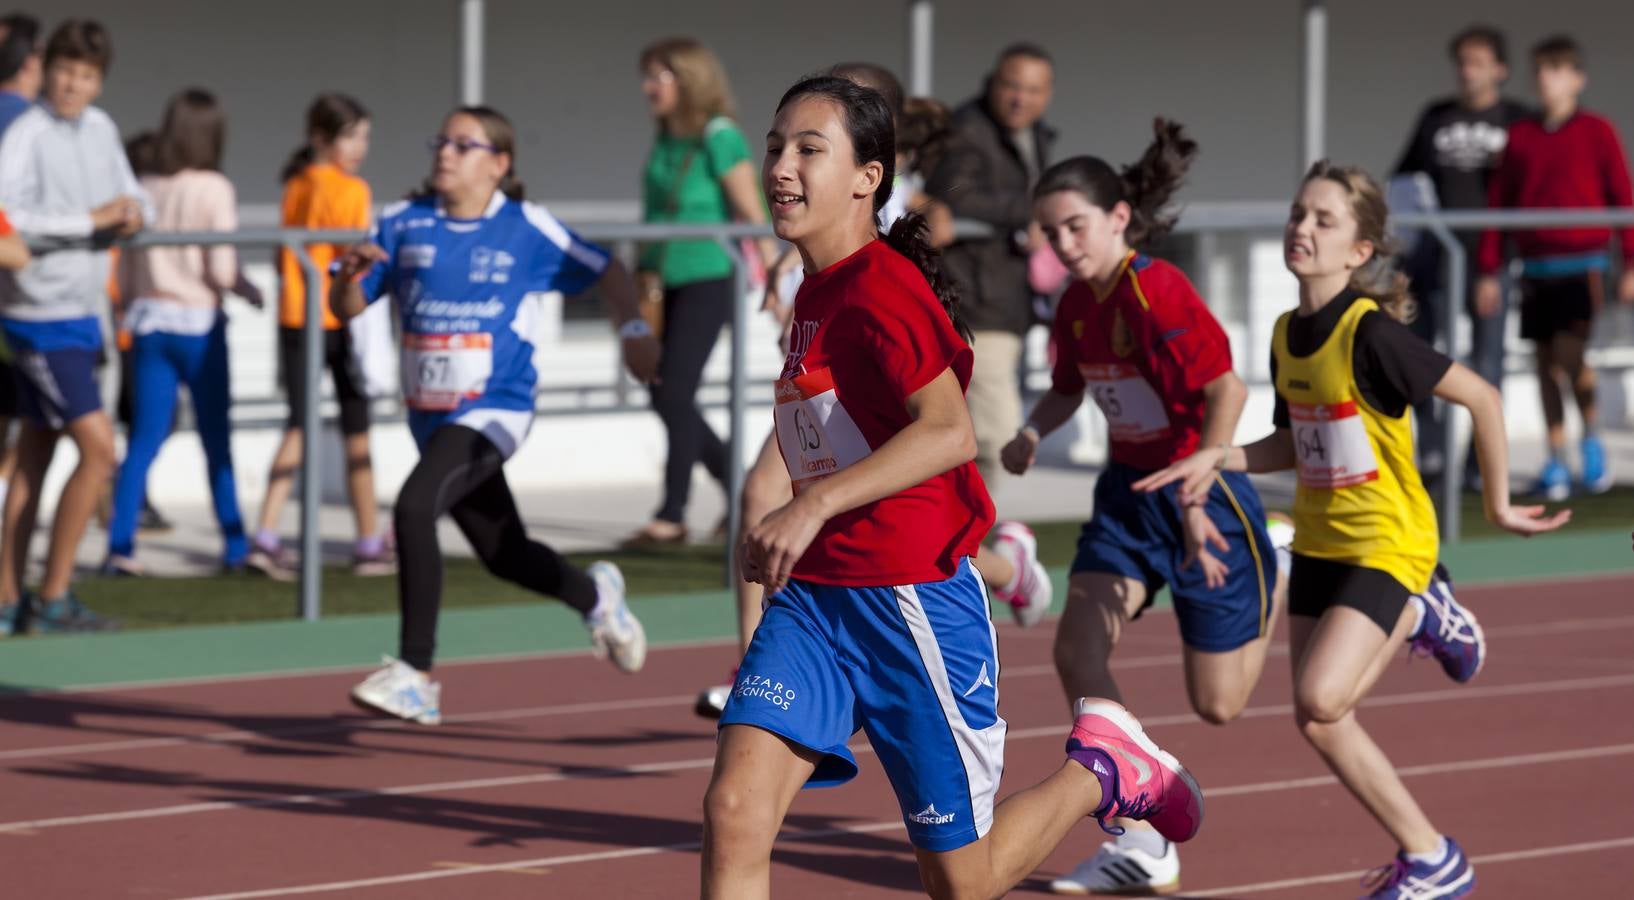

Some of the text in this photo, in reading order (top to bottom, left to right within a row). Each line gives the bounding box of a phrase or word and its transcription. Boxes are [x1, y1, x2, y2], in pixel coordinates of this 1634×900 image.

[419, 356, 450, 385] 67
[794, 408, 821, 452] 63
[1297, 426, 1325, 461] 64
